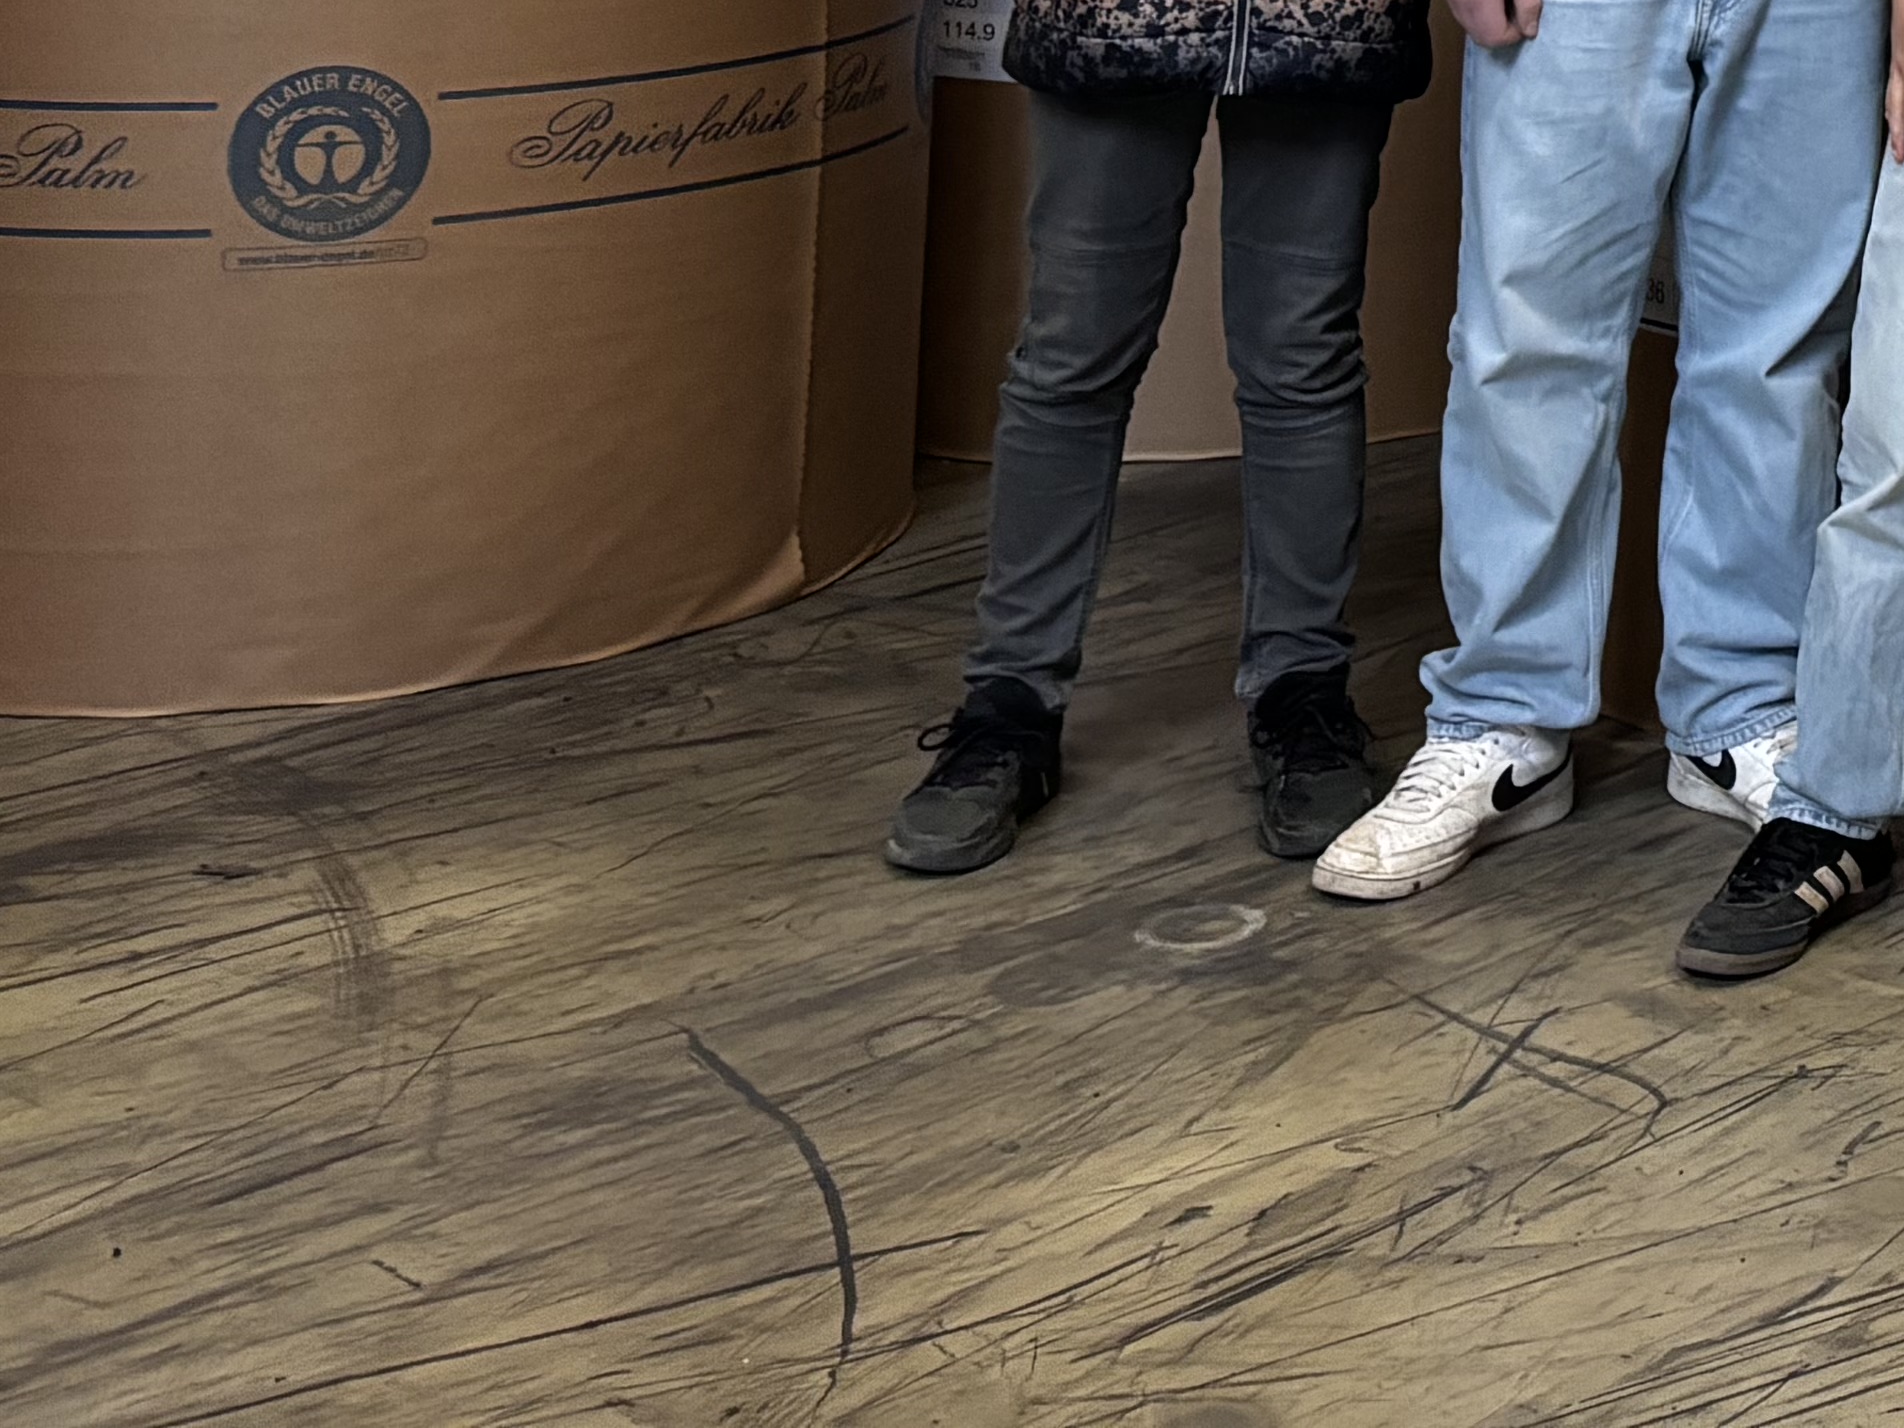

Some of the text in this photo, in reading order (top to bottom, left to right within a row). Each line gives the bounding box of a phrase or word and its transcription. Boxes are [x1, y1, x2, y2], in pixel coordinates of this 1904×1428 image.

[942, 21, 995, 40] 114.9
[255, 73, 410, 119] BLAUER ENGEL
[0, 122, 145, 193] Palm
[511, 83, 800, 183] Papierfabrik
